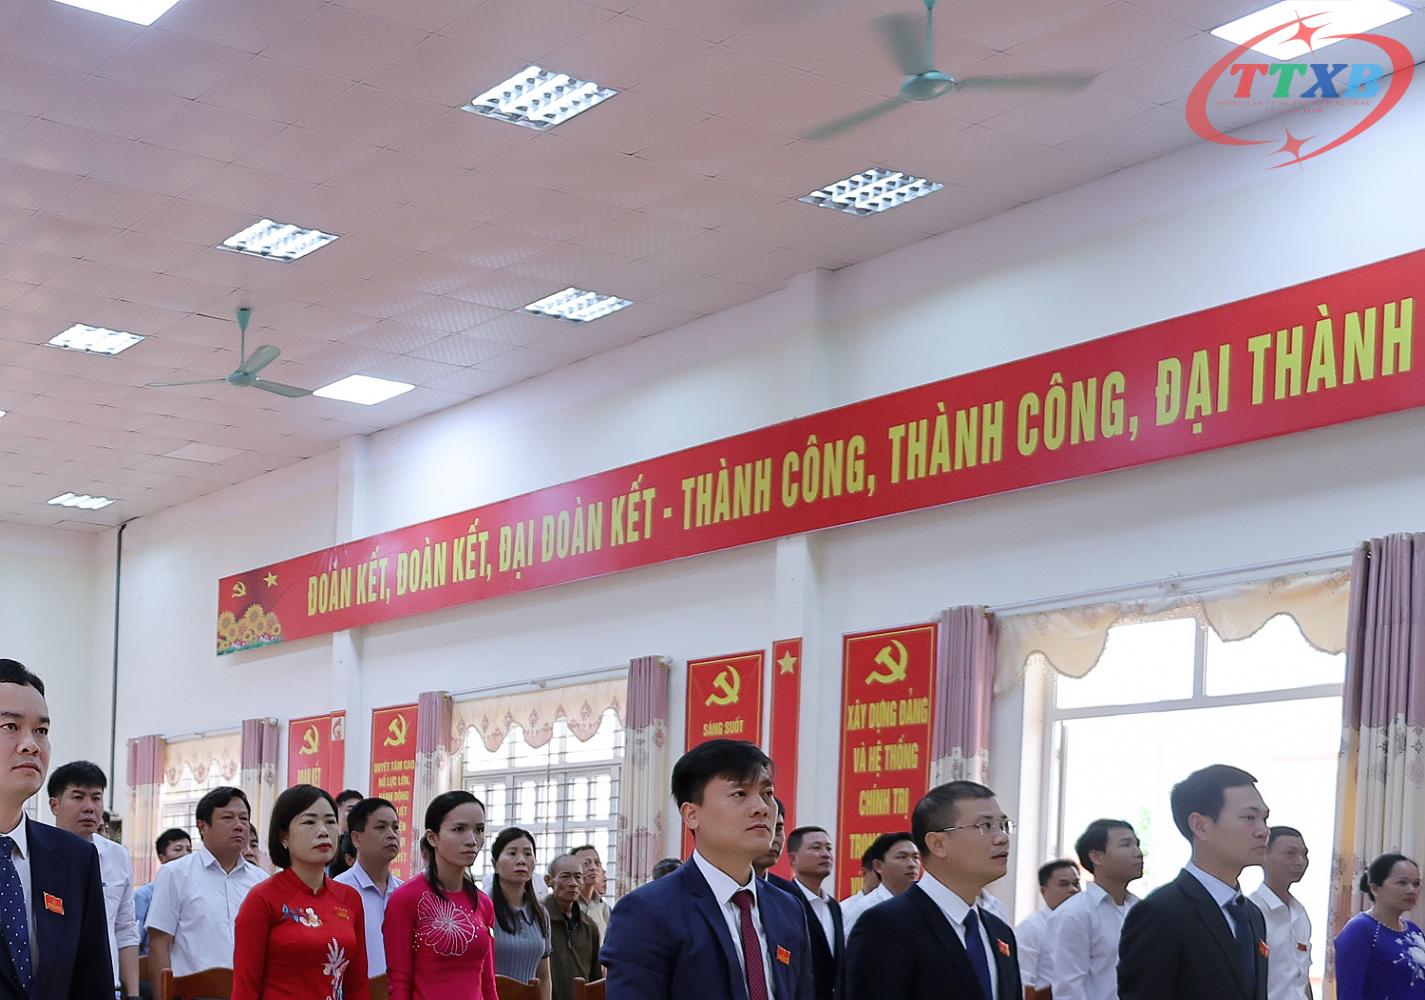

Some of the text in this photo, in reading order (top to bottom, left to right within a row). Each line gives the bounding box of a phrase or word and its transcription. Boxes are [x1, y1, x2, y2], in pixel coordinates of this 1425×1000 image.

[307, 558, 351, 617] ĐOÀN
[355, 546, 391, 604] KẾT,
[396, 536, 447, 596] ĐOÀN
[452, 518, 492, 582] KẾT,
[499, 521, 534, 579] ĐẠI
[541, 496, 603, 563] ĐOÀN
[610, 474, 656, 546] KẾT
[682, 457, 772, 531] THÀNH
[781, 434, 876, 507] CÔNG,
[888, 401, 1003, 484] THÀNH
[1016, 371, 1139, 455] CÔNG,
[1155, 343, 1230, 434] ĐẠI
[1247, 297, 1415, 406] THÀNH
[703, 715, 744, 736] SÁNG SUỐT
[847, 699, 867, 730] XÂY
[869, 699, 897, 733] DỰNG
[854, 734, 919, 777] VÀ HỆ THỐNG
[859, 784, 909, 819] CHÍNH TRỊ
[850, 833, 882, 859] TRO
